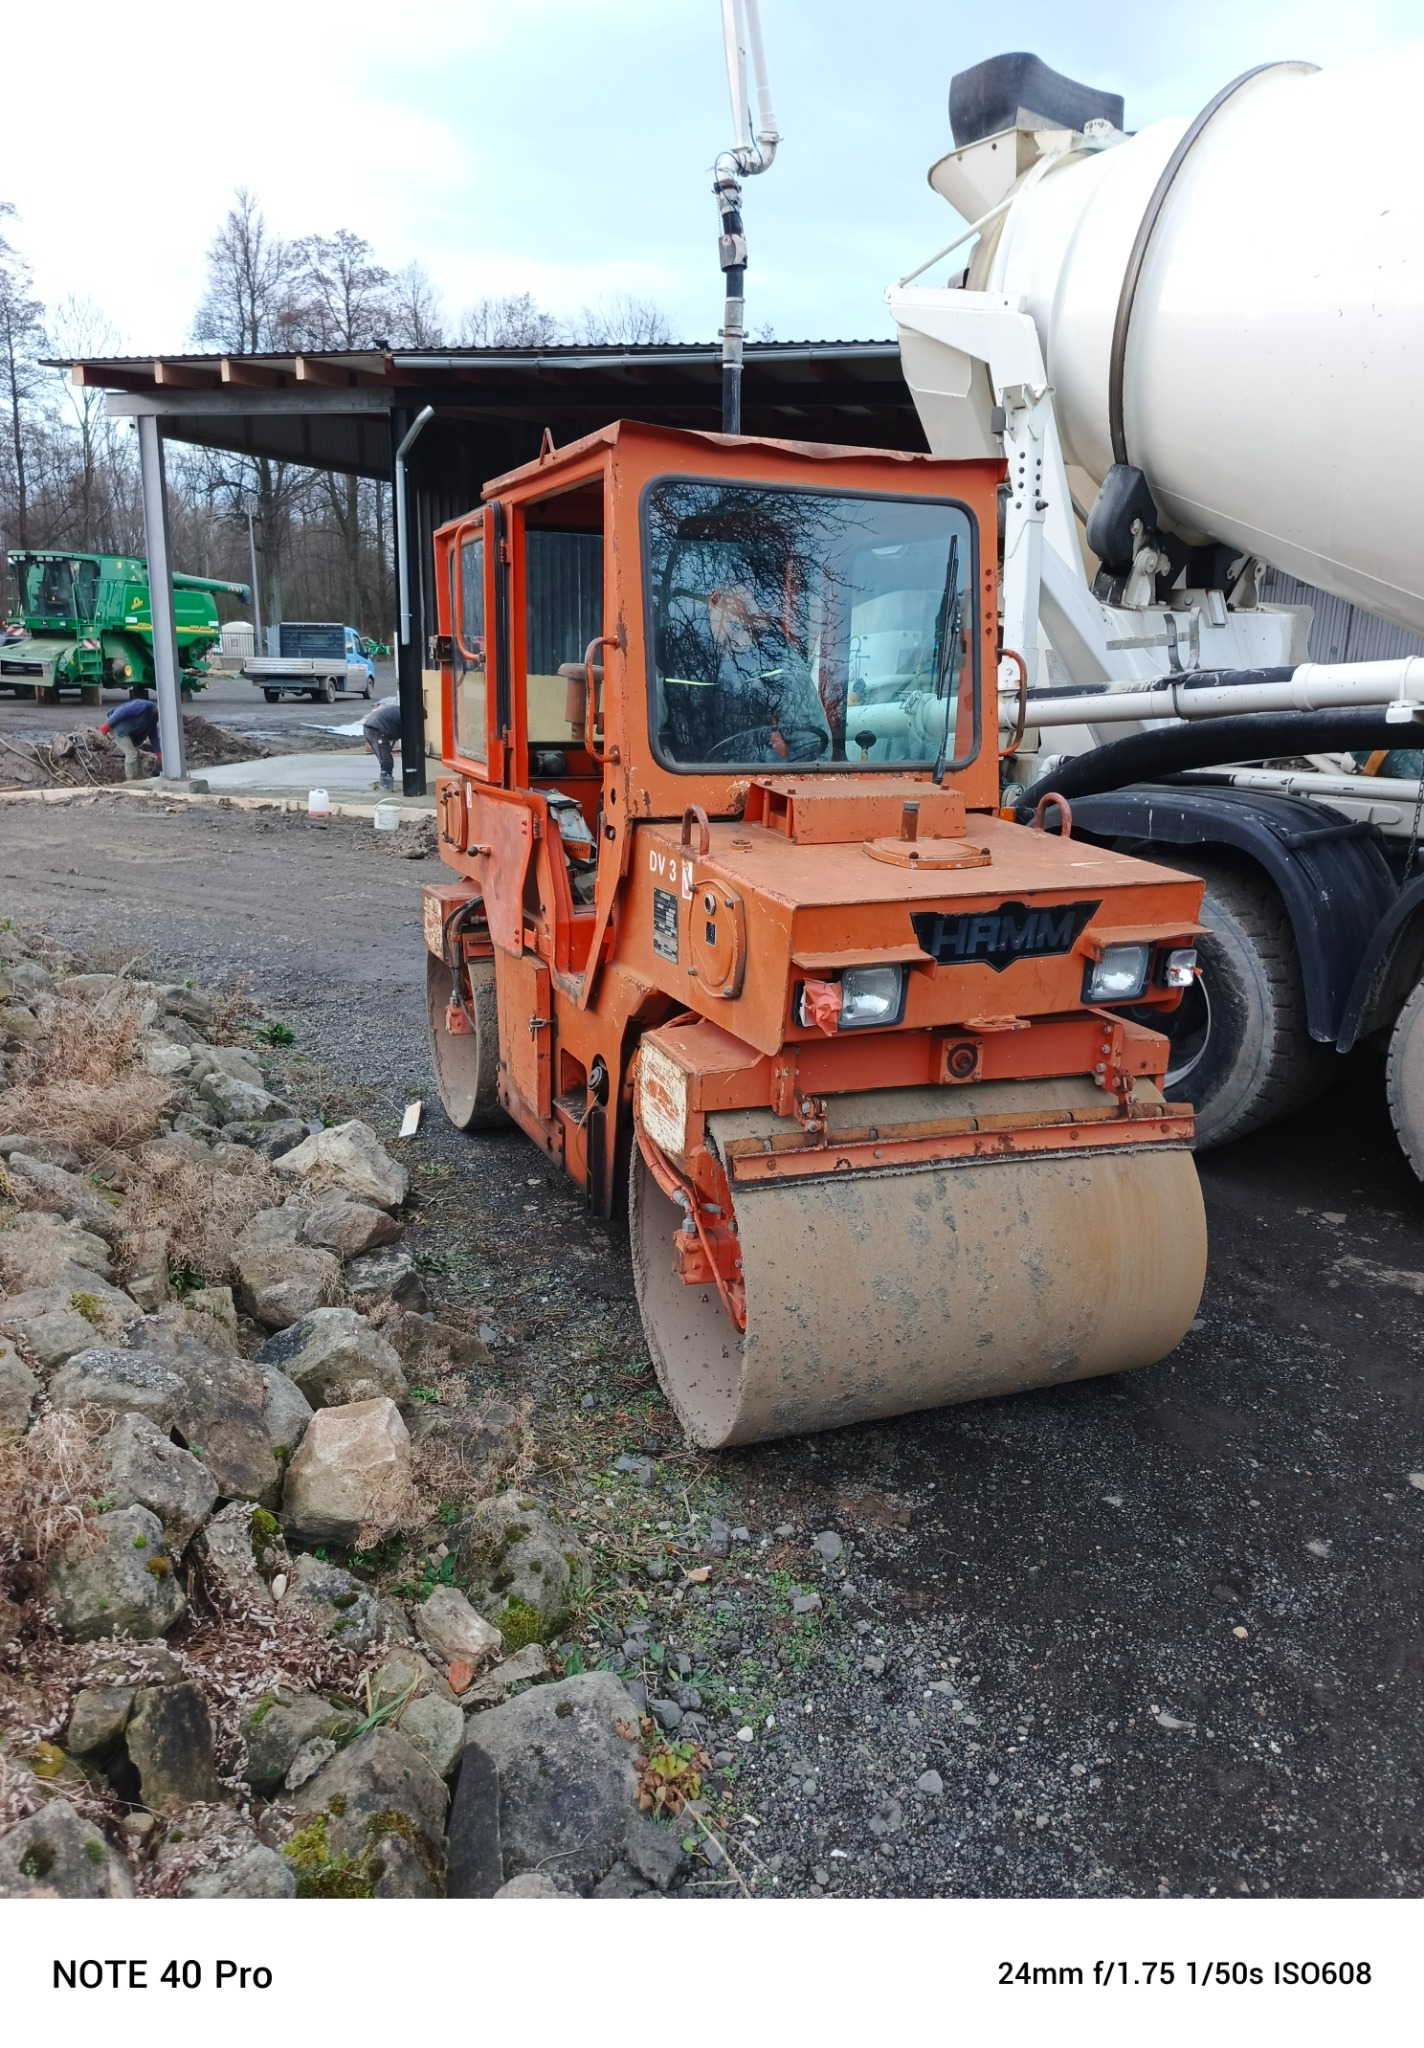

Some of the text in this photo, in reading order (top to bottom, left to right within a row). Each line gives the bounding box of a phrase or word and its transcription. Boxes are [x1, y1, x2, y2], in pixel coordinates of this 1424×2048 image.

[649, 849, 677, 882] DV 3
[930, 911, 1076, 956] HAMM
